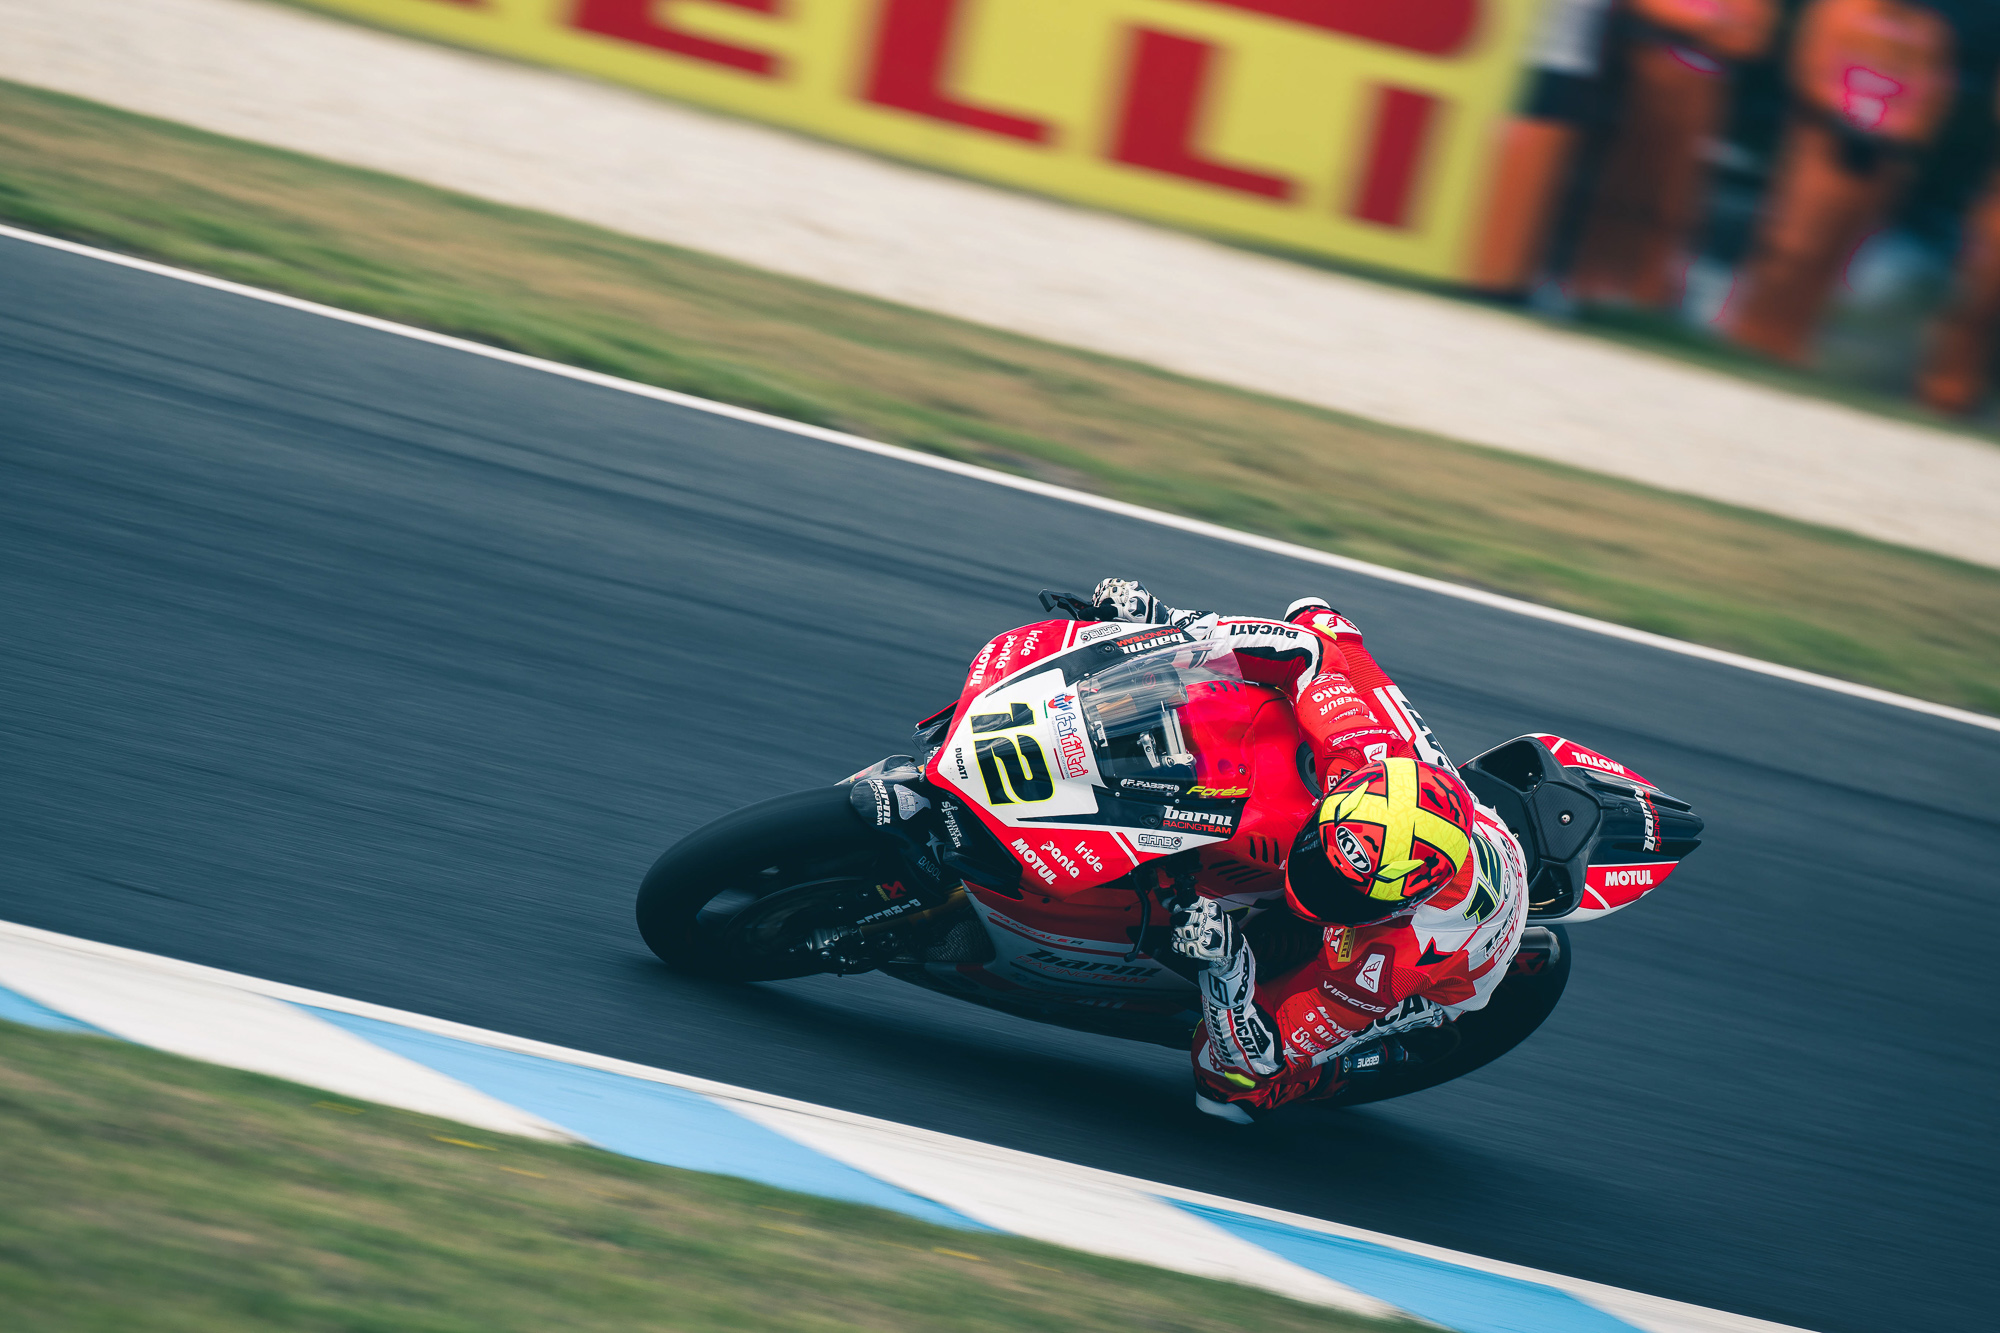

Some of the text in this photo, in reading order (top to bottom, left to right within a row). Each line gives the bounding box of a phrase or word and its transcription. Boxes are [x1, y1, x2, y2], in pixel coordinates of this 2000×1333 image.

[1020, 630, 1043, 656] Iride
[1120, 633, 1189, 654] barni
[1230, 624, 1299, 641] DUCATI
[969, 643, 996, 686] MOTUL
[1332, 729, 1399, 747] VIRCOS
[954, 747, 969, 780] DUCATI
[970, 702, 1055, 806] 12
[1572, 751, 1625, 774] MOTUL
[1186, 786, 1248, 796] Forés
[1163, 805, 1233, 826] barni
[1163, 820, 1231, 834] RACINGTEAM
[944, 820, 961, 848] FILTER
[1337, 829, 1369, 864] KYT
[1011, 838, 1057, 885] MOTUL
[1074, 841, 1103, 872] Iride
[1605, 870, 1653, 887] MOTUL
[856, 898, 921, 925] PIRELLI
[1026, 948, 1163, 979] barni
[1323, 980, 1387, 1013] VIRCOS
[1232, 1003, 1262, 1060] DUCATI
